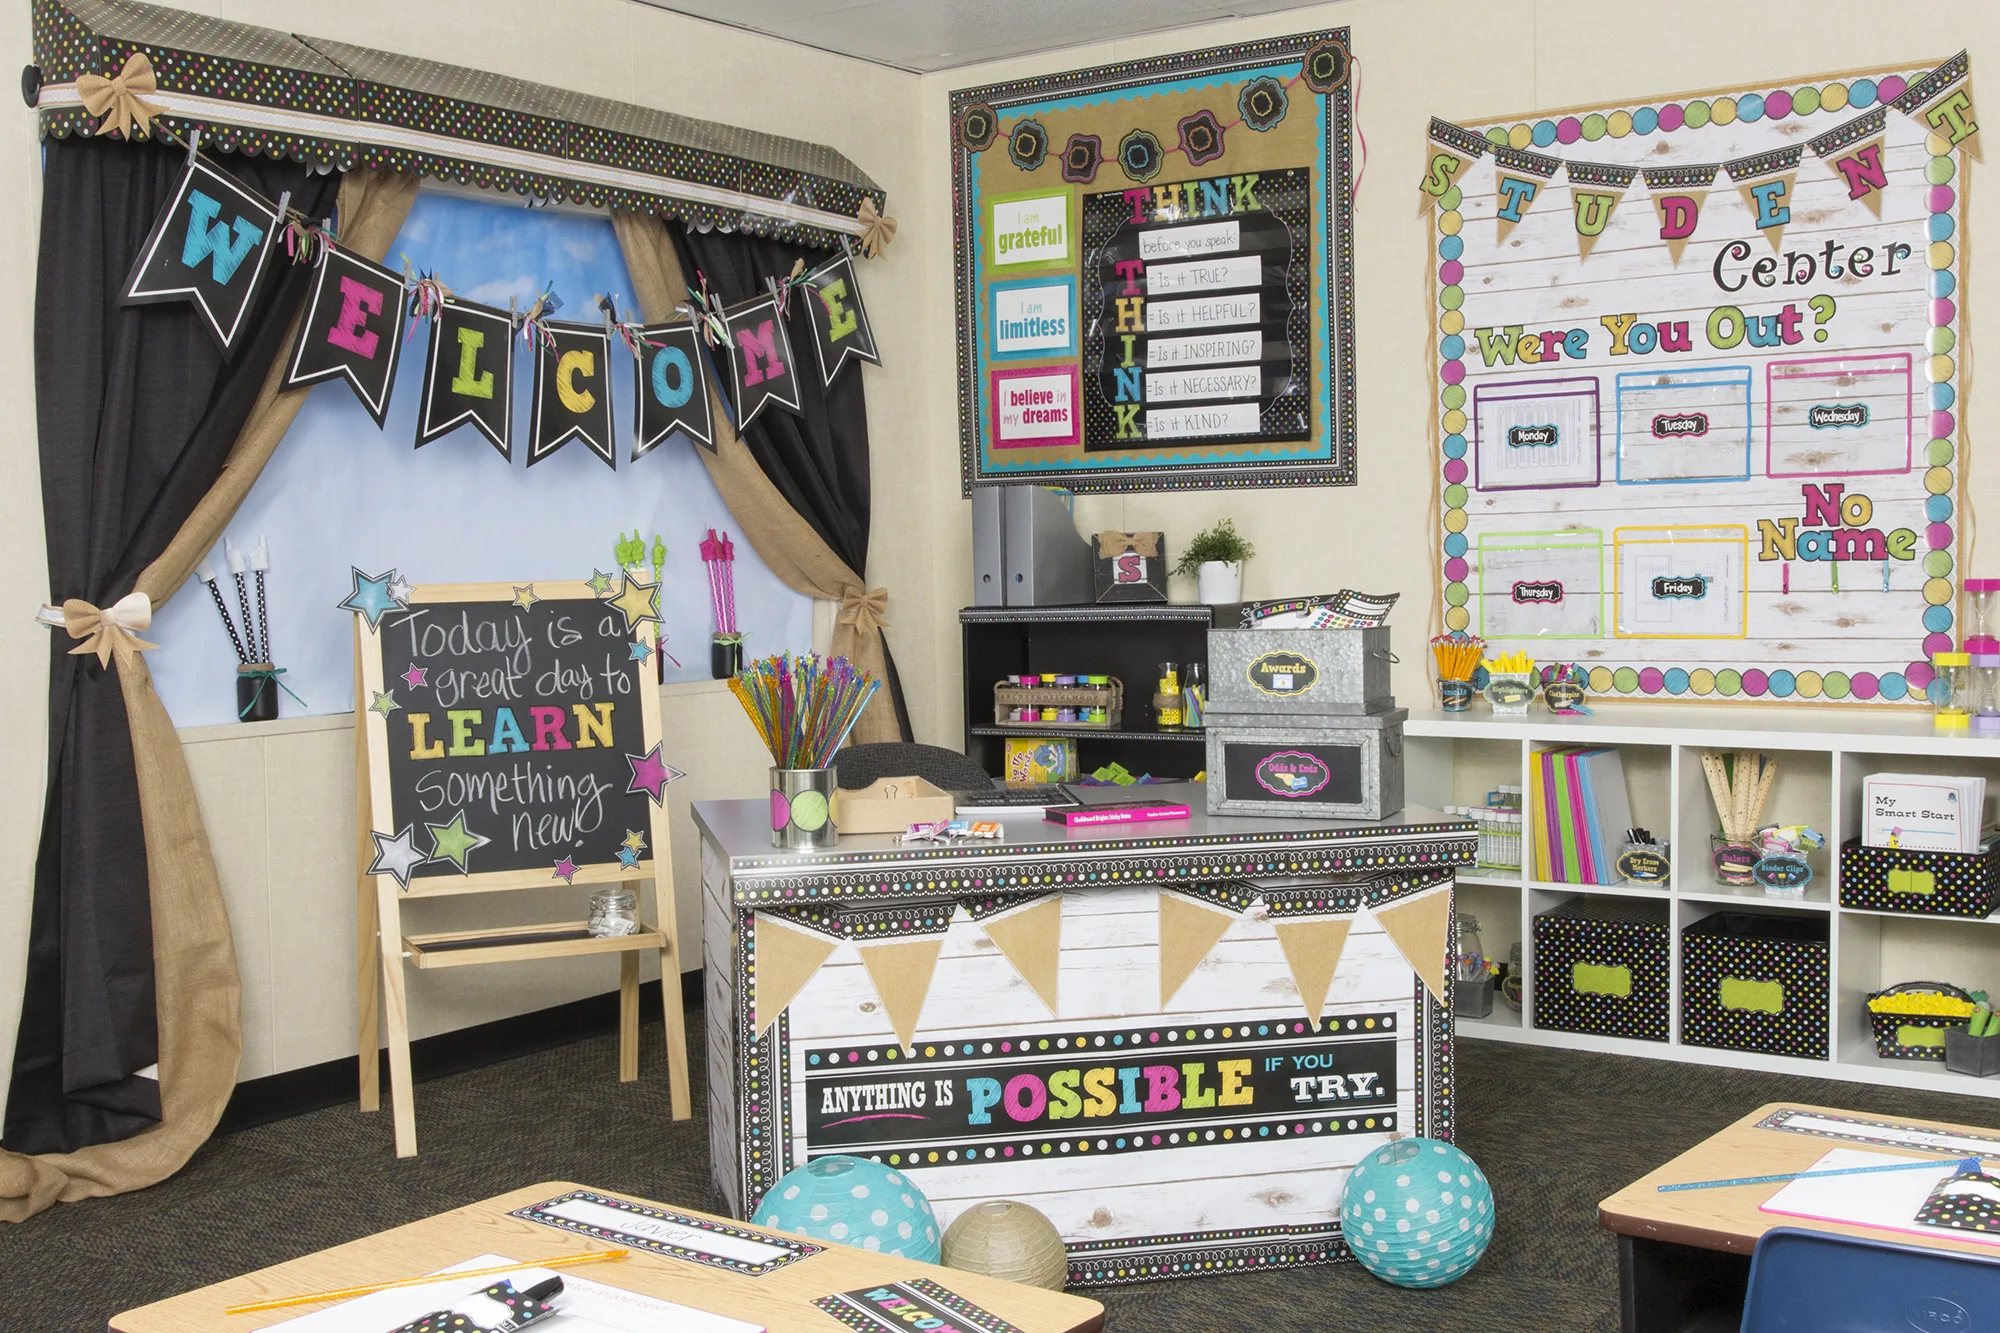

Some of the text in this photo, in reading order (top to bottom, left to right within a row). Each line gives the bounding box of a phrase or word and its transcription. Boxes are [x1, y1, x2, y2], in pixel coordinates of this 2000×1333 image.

[1418, 89, 1978, 240] STUDENT
[1124, 174, 1261, 224] THINK
[1023, 212, 1040, 224] am
[998, 223, 1063, 254] grateful
[1142, 236, 1180, 253] before
[1185, 236, 1202, 253] you
[1713, 240, 1911, 292] Center
[1160, 273, 1170, 288] Is
[1177, 272, 1186, 286] it
[1190, 267, 1228, 285] TRUE?
[181, 189, 858, 413] WELCOME
[1027, 303, 1042, 314] am
[1158, 309, 1170, 325] Is
[1177, 309, 1186, 323] it
[1192, 302, 1256, 322] HELPFUL?
[1000, 317, 1066, 340] limitless
[1474, 294, 1837, 367] Were You Out?
[1158, 346, 1168, 361] Is
[1171, 348, 1179, 360] it
[1184, 340, 1256, 360] INSPIRING?
[1154, 381, 1164, 396] Is
[1170, 381, 1178, 395] it
[1183, 375, 1257, 394] NECESSARY?
[1010, 389, 1053, 406] believe
[1056, 389, 1066, 403] in
[1003, 408, 1068, 426] my dreams
[1154, 418, 1165, 432] Is
[1171, 417, 1179, 431] it
[1185, 414, 1229, 430] KIND?
[1662, 419, 1697, 432] Tuesday
[1814, 411, 1860, 423] Wednesday
[1518, 430, 1549, 443] Monday
[1802, 483, 1873, 527] No
[1757, 517, 1917, 561] Name
[1118, 555, 1142, 583] S
[1520, 586, 1554, 600] Thursday
[1663, 582, 1693, 594] Friday
[1257, 602, 1304, 618] AMAZING
[389, 609, 621, 675] Today is a
[1260, 662, 1306, 674] Awards
[435, 653, 631, 708] great day to
[1491, 685, 1529, 695] Highlighters
[407, 701, 616, 760] LEARN
[1268, 763, 1318, 774] Odds & Ends
[1875, 796, 1896, 807] My
[1875, 808, 1955, 820] Smart Start
[1629, 856, 1659, 866] Dry Erase
[1721, 854, 1750, 863] Rulers
[1632, 864, 1657, 873] Markers
[1761, 864, 1803, 873] Binder Clips
[820, 1053, 1334, 1126] ANYTHING IS POSSIBLE IF YOU
[1290, 1072, 1386, 1103] TRY.
[620, 1218, 702, 1242] Javier
